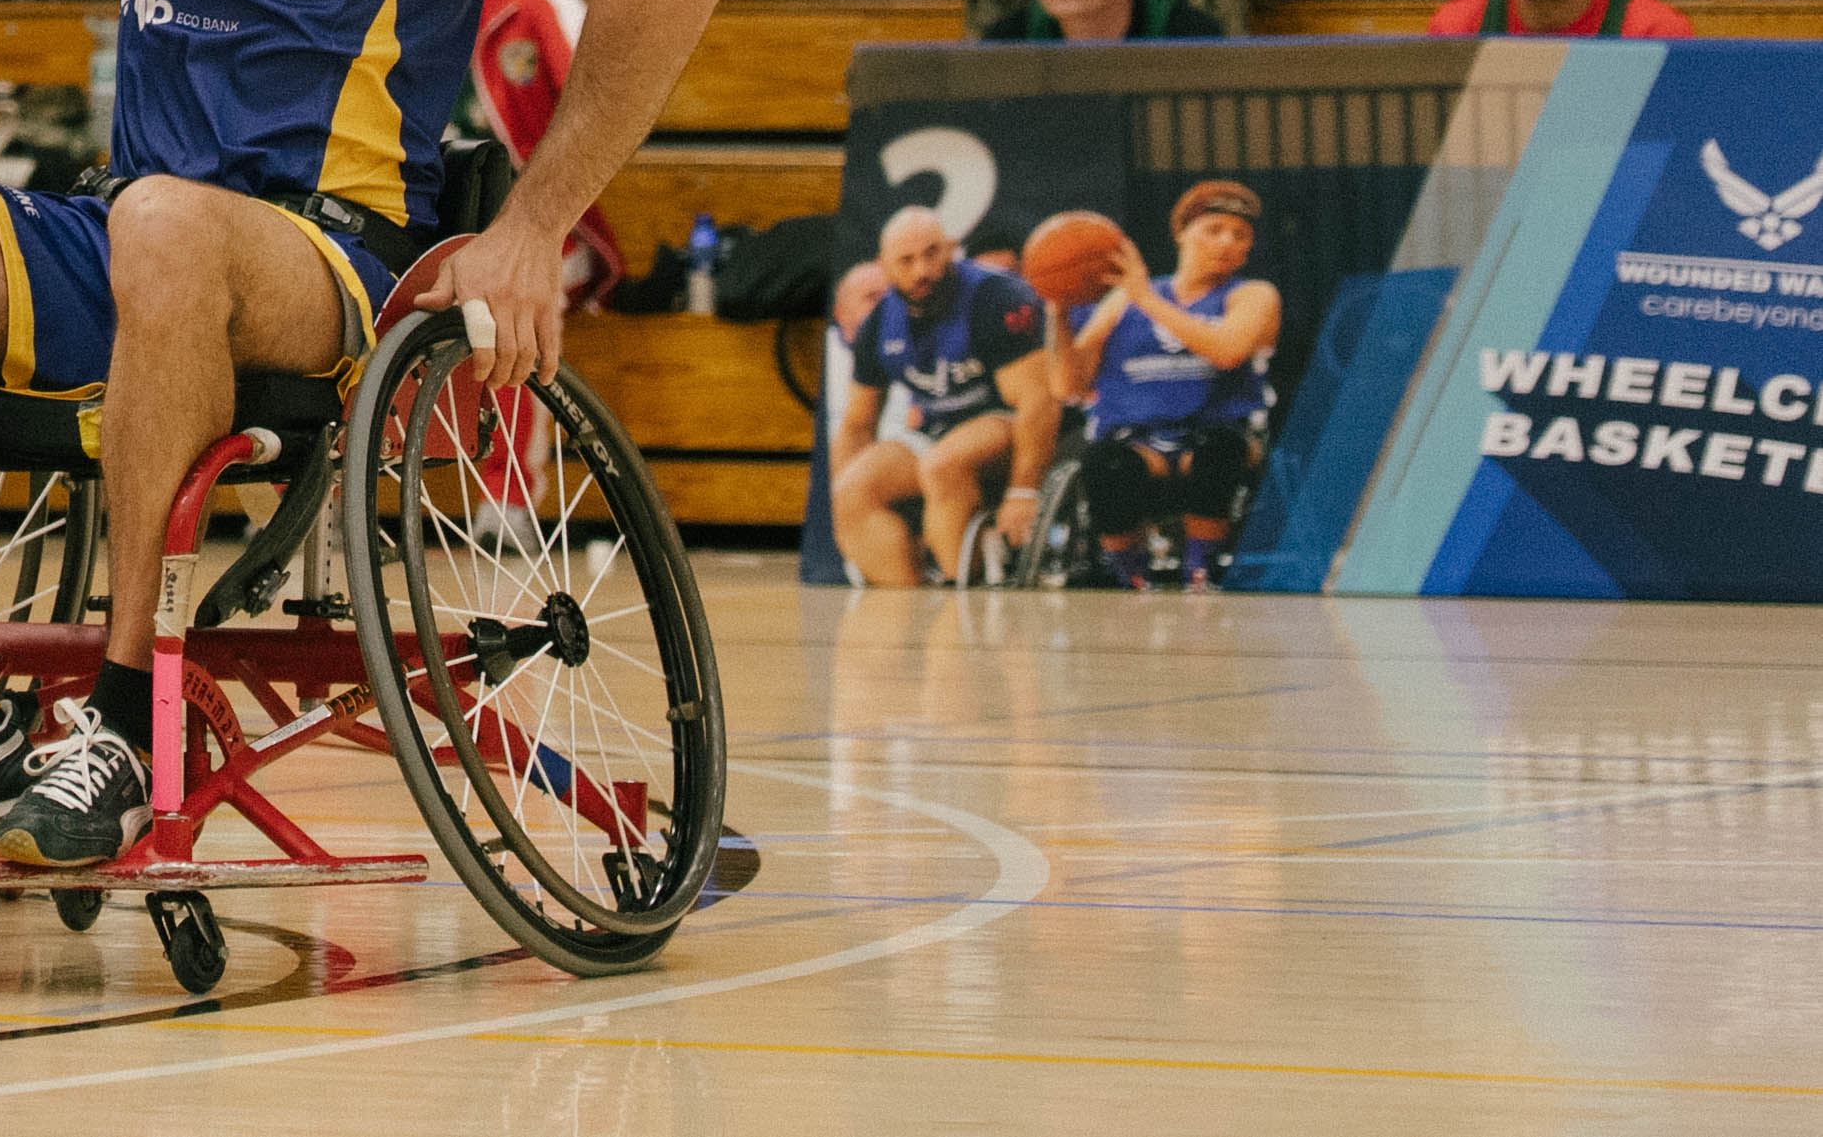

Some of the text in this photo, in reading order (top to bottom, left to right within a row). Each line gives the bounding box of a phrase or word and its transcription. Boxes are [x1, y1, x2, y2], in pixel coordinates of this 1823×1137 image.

[176, 12, 200, 28] ECO
[202, 16, 240, 33] BANK
[1617, 262, 1773, 294] WOUNDED
[1480, 347, 1823, 426] WHEELC
